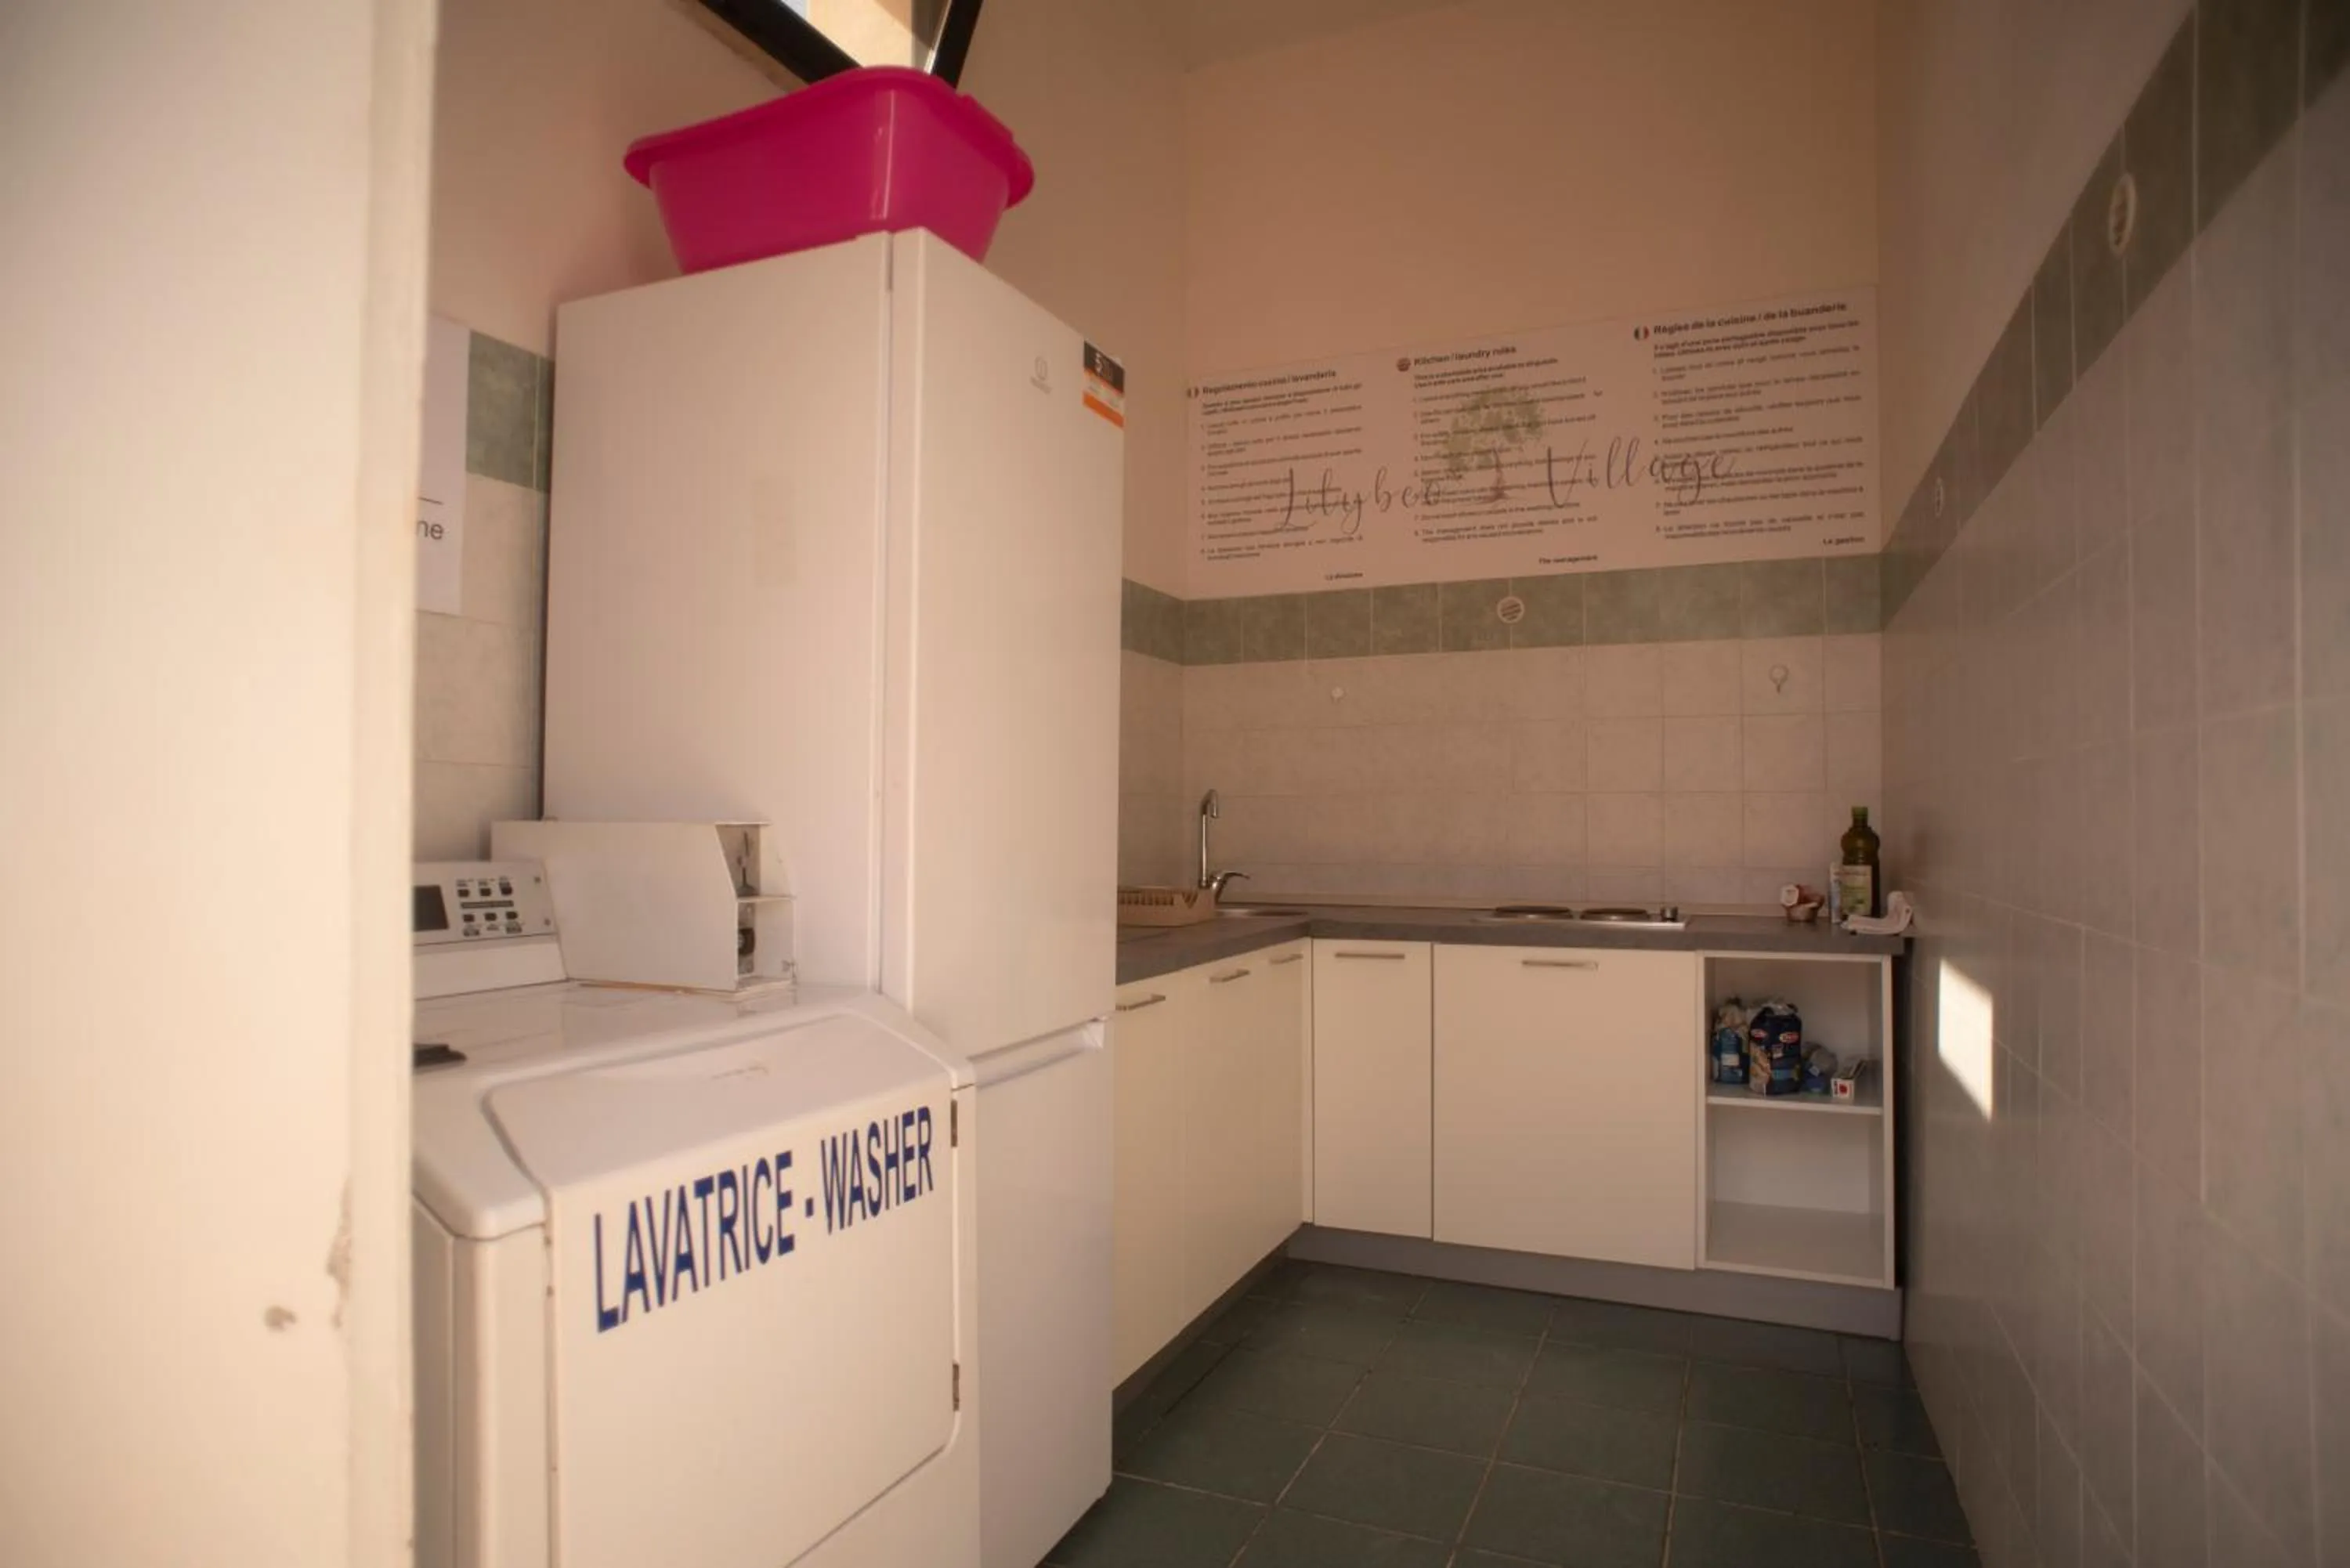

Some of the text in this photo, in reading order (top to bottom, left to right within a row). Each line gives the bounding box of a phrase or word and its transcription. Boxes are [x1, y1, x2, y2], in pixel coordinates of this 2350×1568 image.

[1763, 311, 1777, 321] de
[1548, 438, 1736, 508] Village
[594, 1148, 795, 1333] LAVATRICE
[820, 1105, 935, 1236] WASHER
